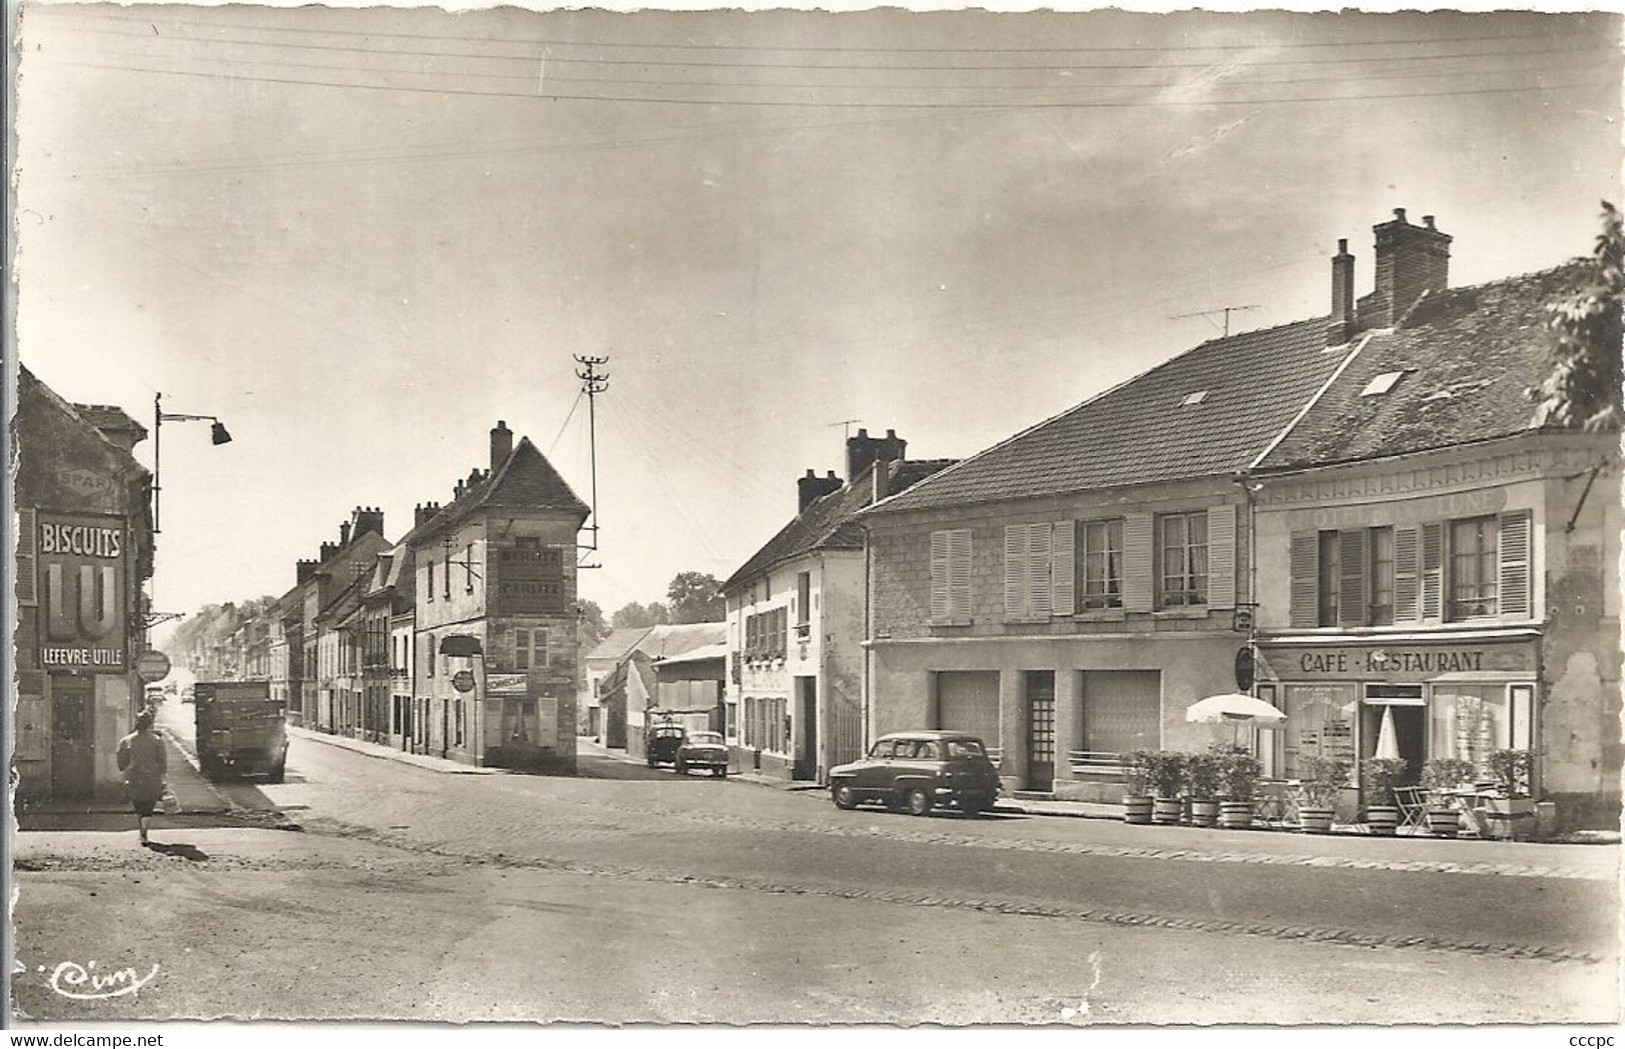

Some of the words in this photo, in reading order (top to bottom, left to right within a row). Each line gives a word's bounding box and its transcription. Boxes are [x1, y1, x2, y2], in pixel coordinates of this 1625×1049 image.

[60, 474, 106, 488] SPAR
[42, 523, 120, 557] BISCUITS
[49, 563, 115, 638] LU
[1300, 650, 1348, 672] CAFÉ
[1366, 650, 1484, 672] RESTAURANT
